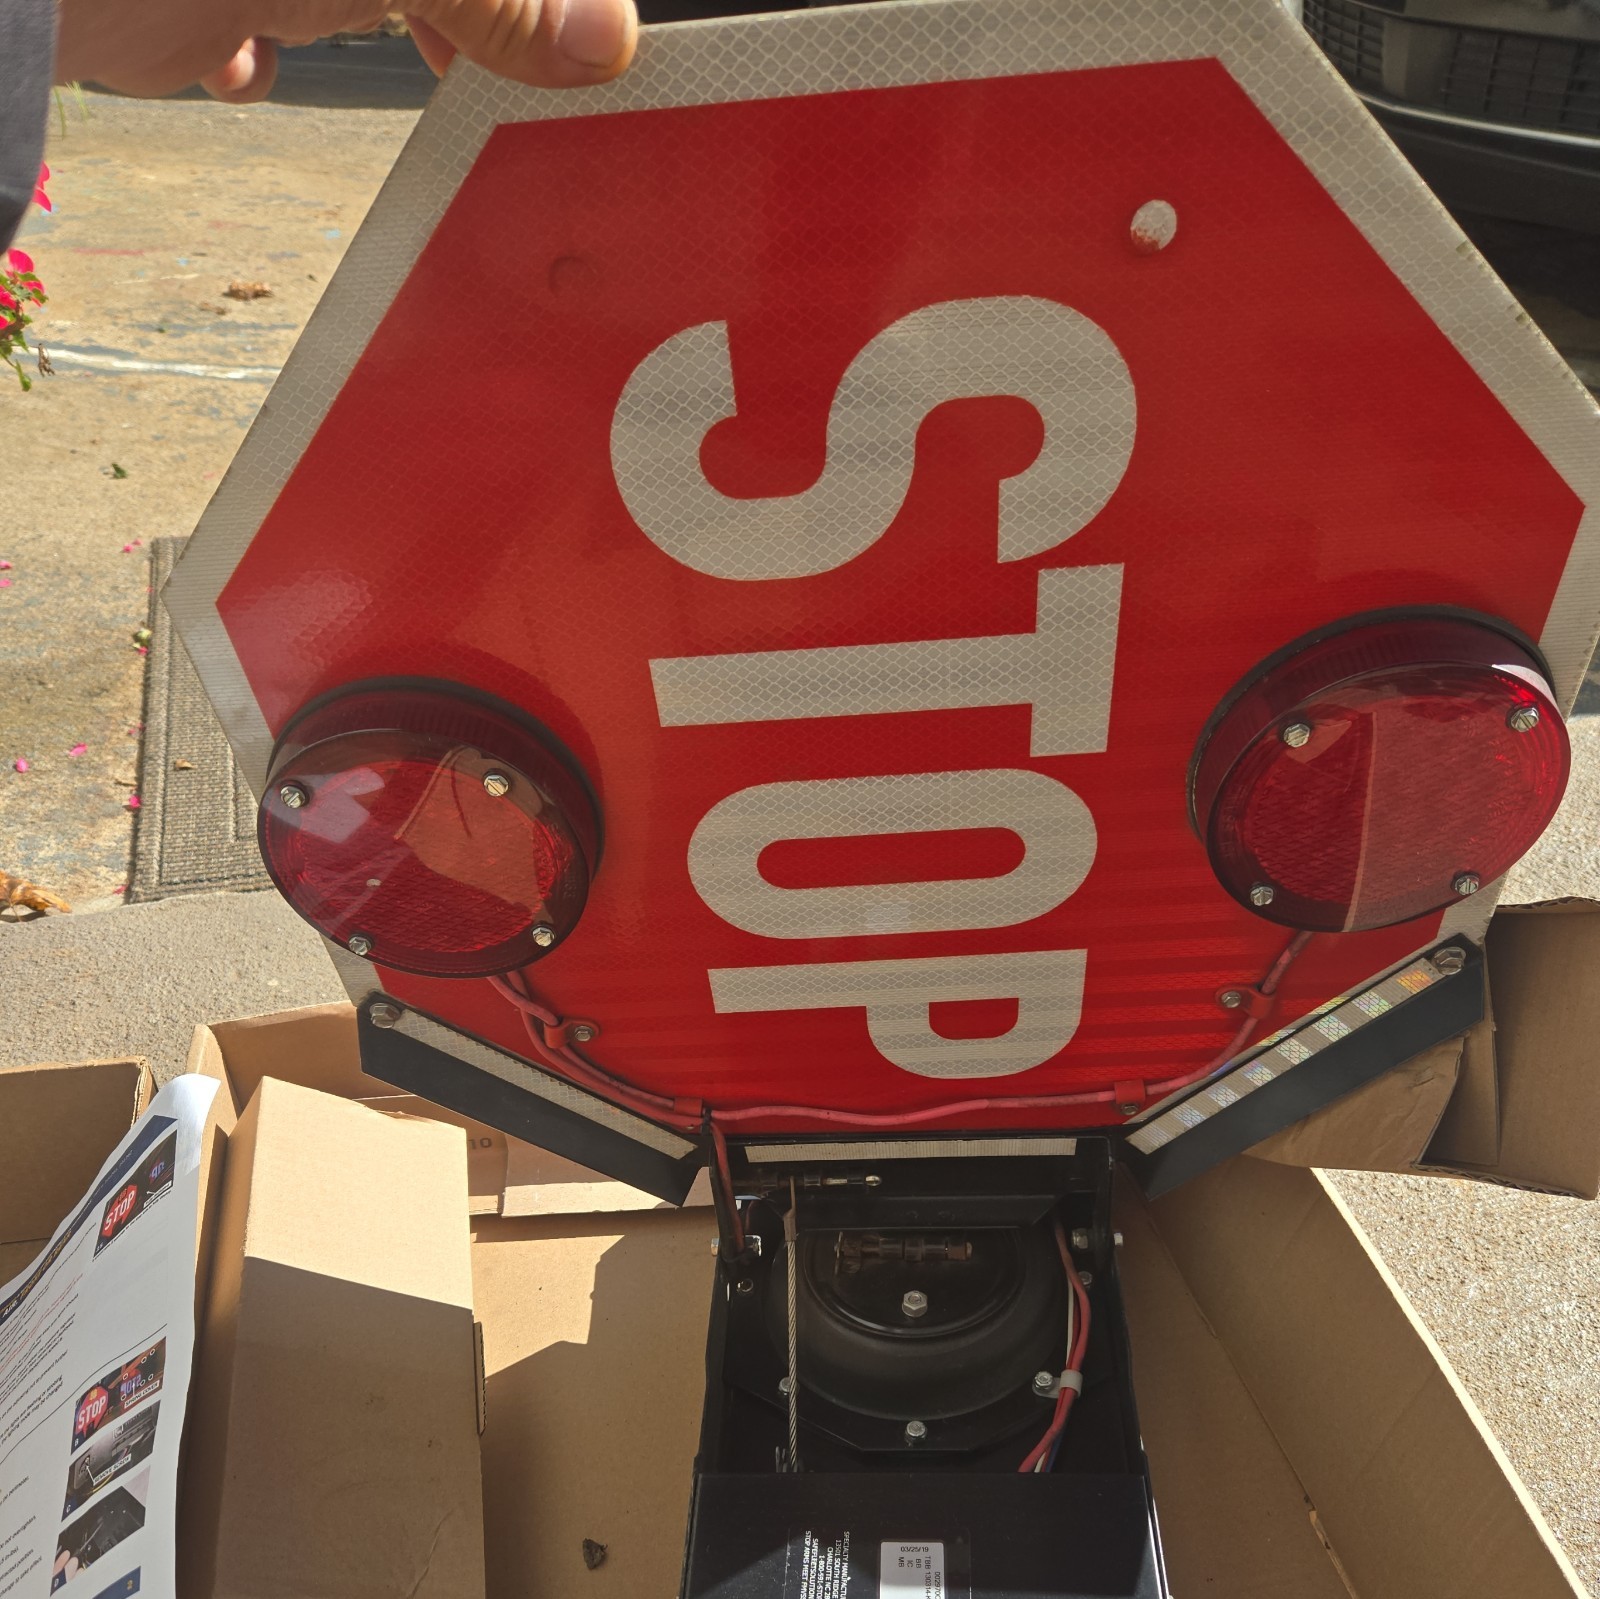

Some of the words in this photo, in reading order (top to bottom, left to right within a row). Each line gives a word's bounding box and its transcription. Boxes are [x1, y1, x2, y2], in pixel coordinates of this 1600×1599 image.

[609, 295, 1138, 1080] STOP
[104, 1190, 135, 1231] STOP
[142, 1382, 159, 1396] COVER
[78, 1395, 107, 1431] STOP
[834, 1539, 842, 1557] 13501
[842, 1530, 851, 1562] SPECIALTY
[825, 1546, 834, 1581] CHARLOTTE
[833, 1557, 841, 1579] SOUTH
[897, 1556, 905, 1568] MB
[915, 1558, 922, 1569] BB
[924, 1555, 932, 1570] TBB
[801, 1564, 809, 1581] MEET
[825, 1581, 831, 1592] NC
